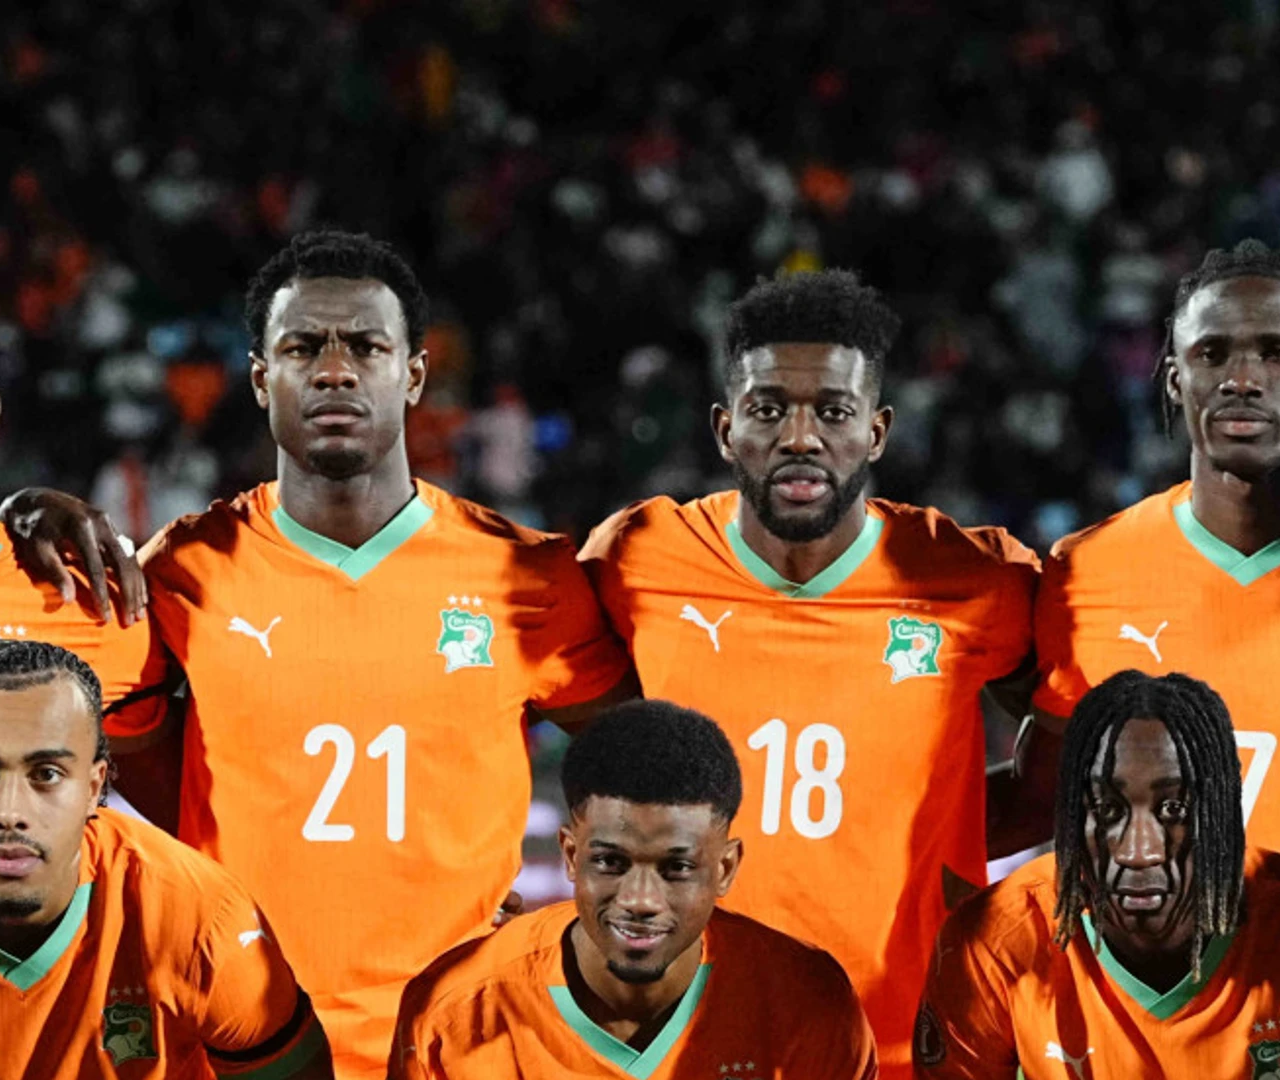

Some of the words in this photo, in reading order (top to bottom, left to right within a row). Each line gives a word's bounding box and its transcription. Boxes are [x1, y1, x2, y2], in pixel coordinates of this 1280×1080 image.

[302, 724, 406, 842] 21
[748, 718, 845, 839] 18
[1233, 731, 1277, 829] 7
